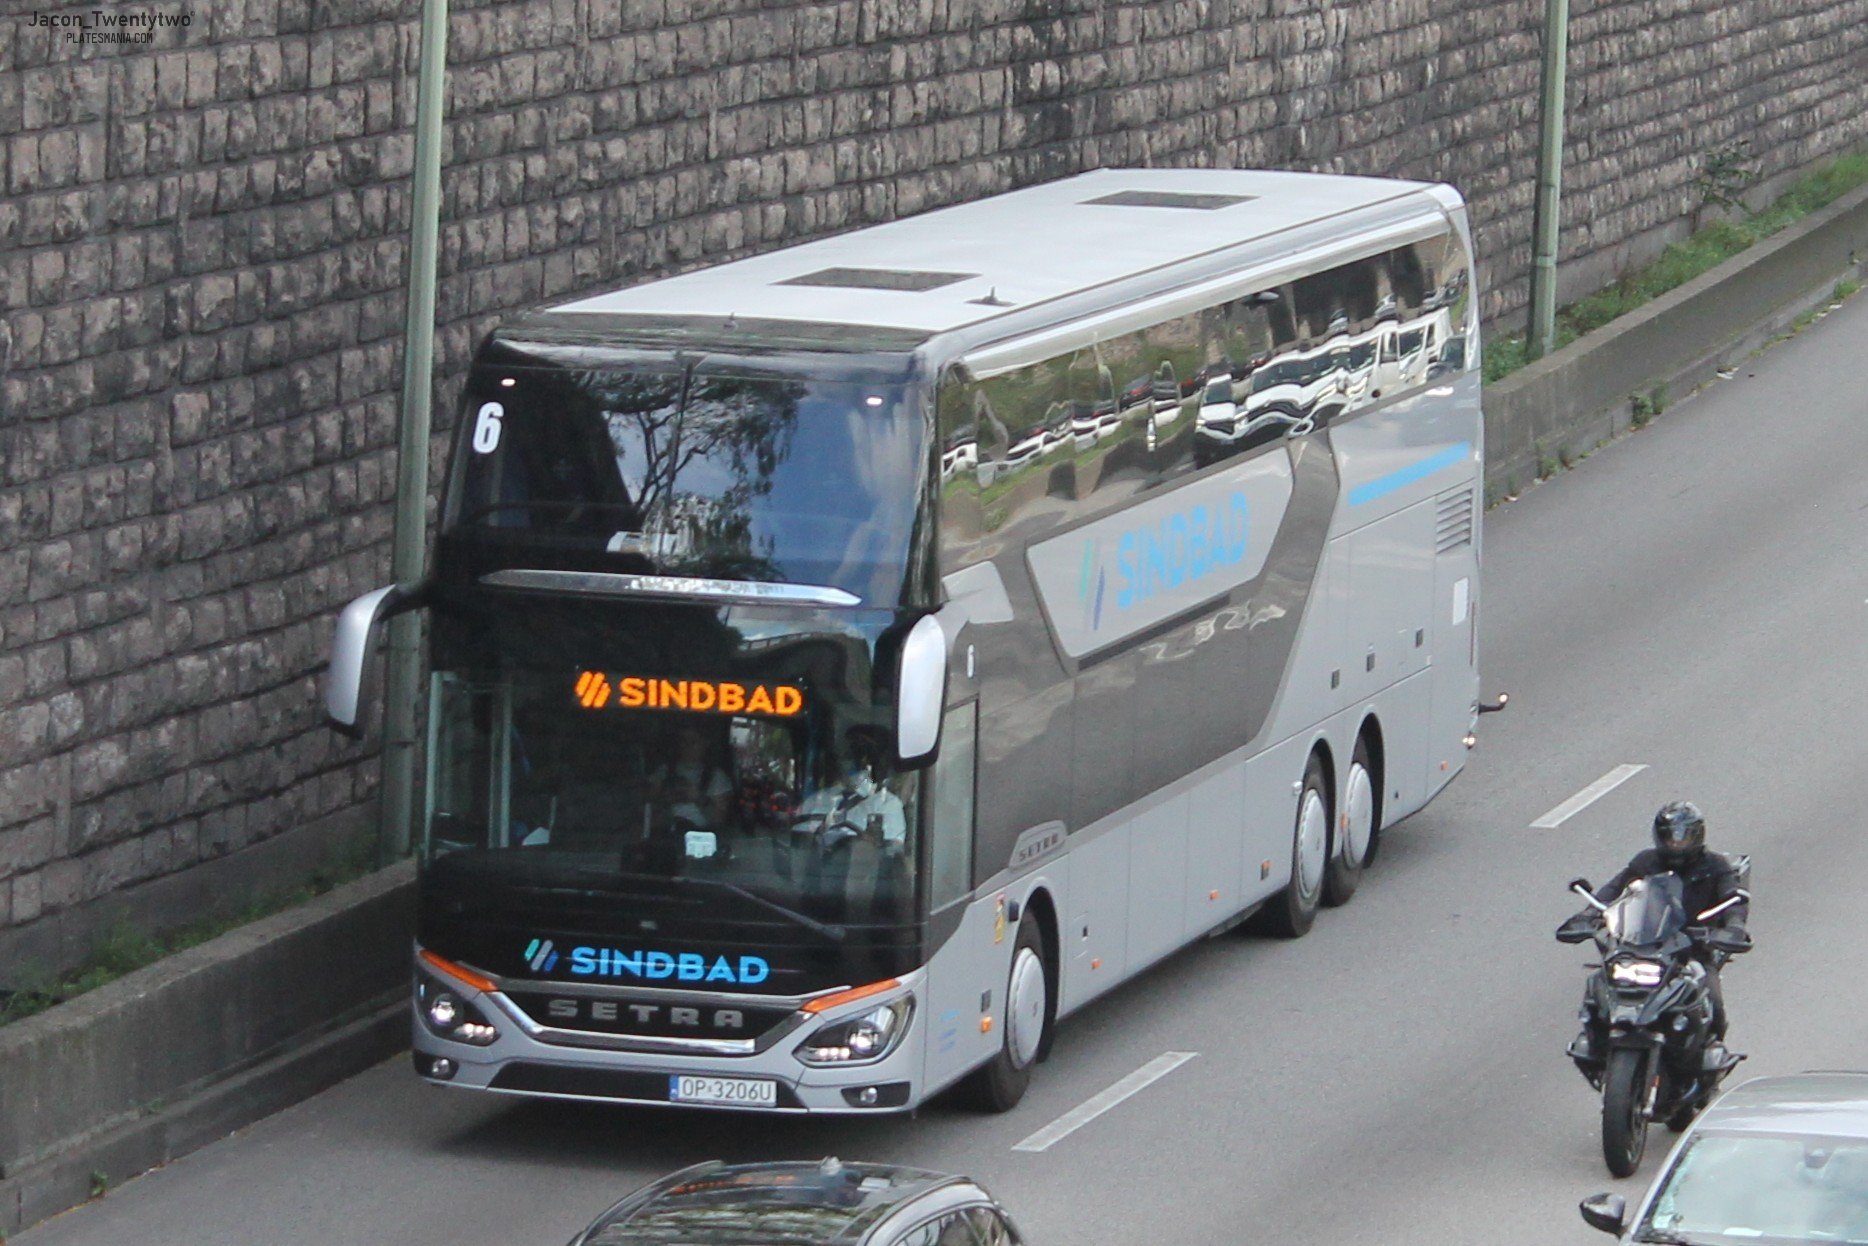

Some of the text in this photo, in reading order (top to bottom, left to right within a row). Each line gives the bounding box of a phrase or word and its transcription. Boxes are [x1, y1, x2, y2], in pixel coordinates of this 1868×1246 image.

[473, 401, 505, 453] 6
[1117, 491, 1248, 611] SINDBAD
[619, 677, 802, 716] SINDBAD
[571, 946, 770, 984] SINDBAD
[548, 999, 744, 1029] SETRA
[682, 1078, 706, 1096] OP
[713, 1080, 772, 1101] 3206U
